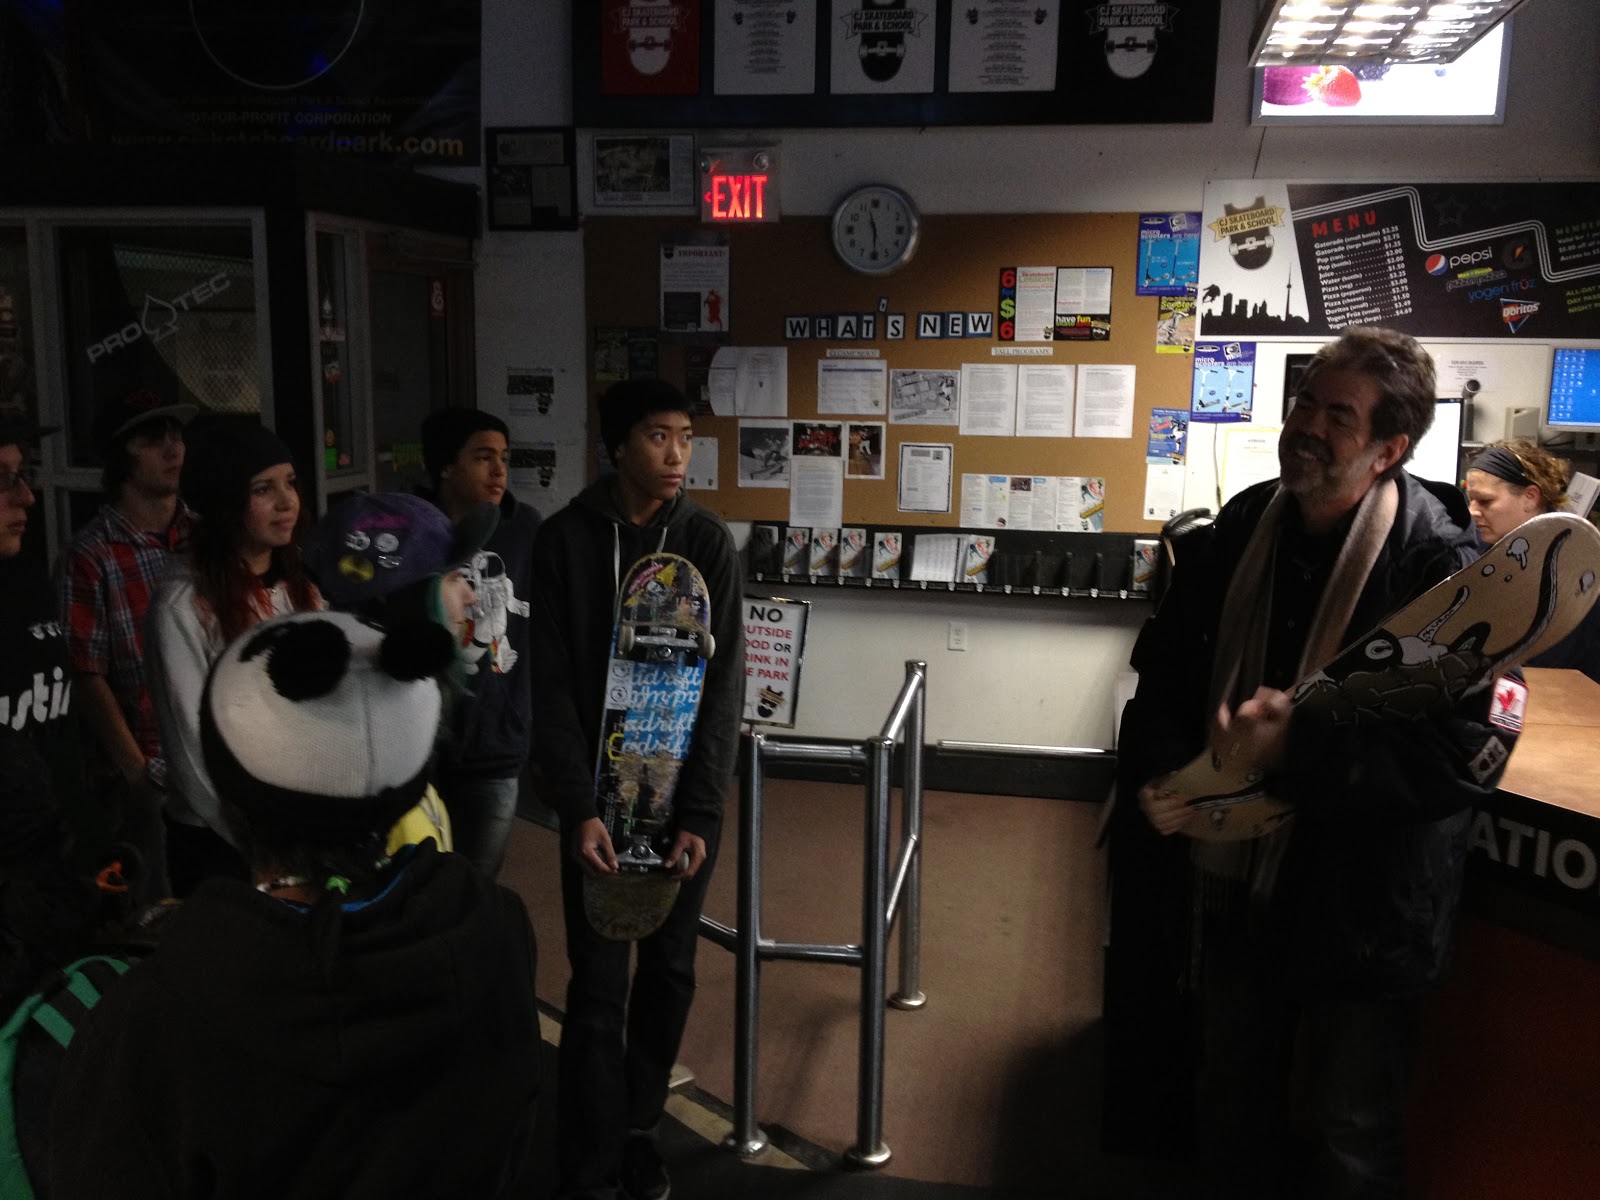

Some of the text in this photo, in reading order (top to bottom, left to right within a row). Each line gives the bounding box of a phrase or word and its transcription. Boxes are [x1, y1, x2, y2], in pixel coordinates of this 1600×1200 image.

[853, 10, 914, 20] CJ SKATEBOARD
[1100, 5, 1166, 16] CJ SKATEBOARD
[853, 20, 912, 30] PARK & SCHOOL
[1100, 15, 1165, 26] PARK & SCHOOL
[189, 111, 289, 125] OT-FOR-PROFIT
[712, 175, 768, 218] EXIT
[1219, 208, 1275, 227] CJ SKATEBOARD
[1220, 216, 1276, 234] PARK & SCHOOL
[1312, 210, 1376, 238] MENU
[1314, 225, 1399, 249] Gatorade (small bottle) $2.25
[1315, 233, 1400, 256] Gatorade (large bottle) $2.75
[1384, 240, 1401, 250] $1.25
[1557, 235, 1573, 245] Valid
[1318, 248, 1403, 272] Pop (bottle) $2.00
[1449, 246, 1493, 269] pepsi
[1560, 252, 1582, 262] Access
[1583, 250, 1591, 258] to
[1001, 269, 1016, 288] 6
[1319, 271, 1335, 280] Juice
[1320, 263, 1405, 286] Water (bottle) $1.50
[1321, 285, 1339, 293] Pizza
[1339, 282, 1354, 291] (veg)
[1323, 292, 1340, 301] Pizza
[1340, 286, 1372, 298] (pepperoni)
[1468, 282, 1510, 304] yogen
[1324, 285, 1409, 308] Pizza (cheese) $2.75
[1325, 292, 1410, 316] Doritos (small) $1.50
[1566, 296, 1582, 306] DAY
[1000, 297, 1015, 319] $
[1327, 313, 1345, 323] Yogen
[1362, 307, 1380, 316] (small)
[1502, 303, 1539, 318] Doritos
[1567, 303, 1592, 314] NIGHT
[87, 272, 231, 364] PRO TEC
[789, 303, 991, 338] WHAT'S NEW
[1055, 314, 1091, 323] have fun
[1328, 321, 1348, 330] Yogen
[1363, 314, 1382, 324] (large)
[1395, 307, 1413, 317] $4.69
[1000, 320, 1015, 340] 6
[750, 605, 782, 622] NO
[743, 624, 792, 639] UTSIDE
[745, 640, 791, 653] OOD OR
[744, 652, 789, 667] RINK IN
[744, 667, 789, 681] E PARK
[1466, 809, 1600, 890] ATIO
